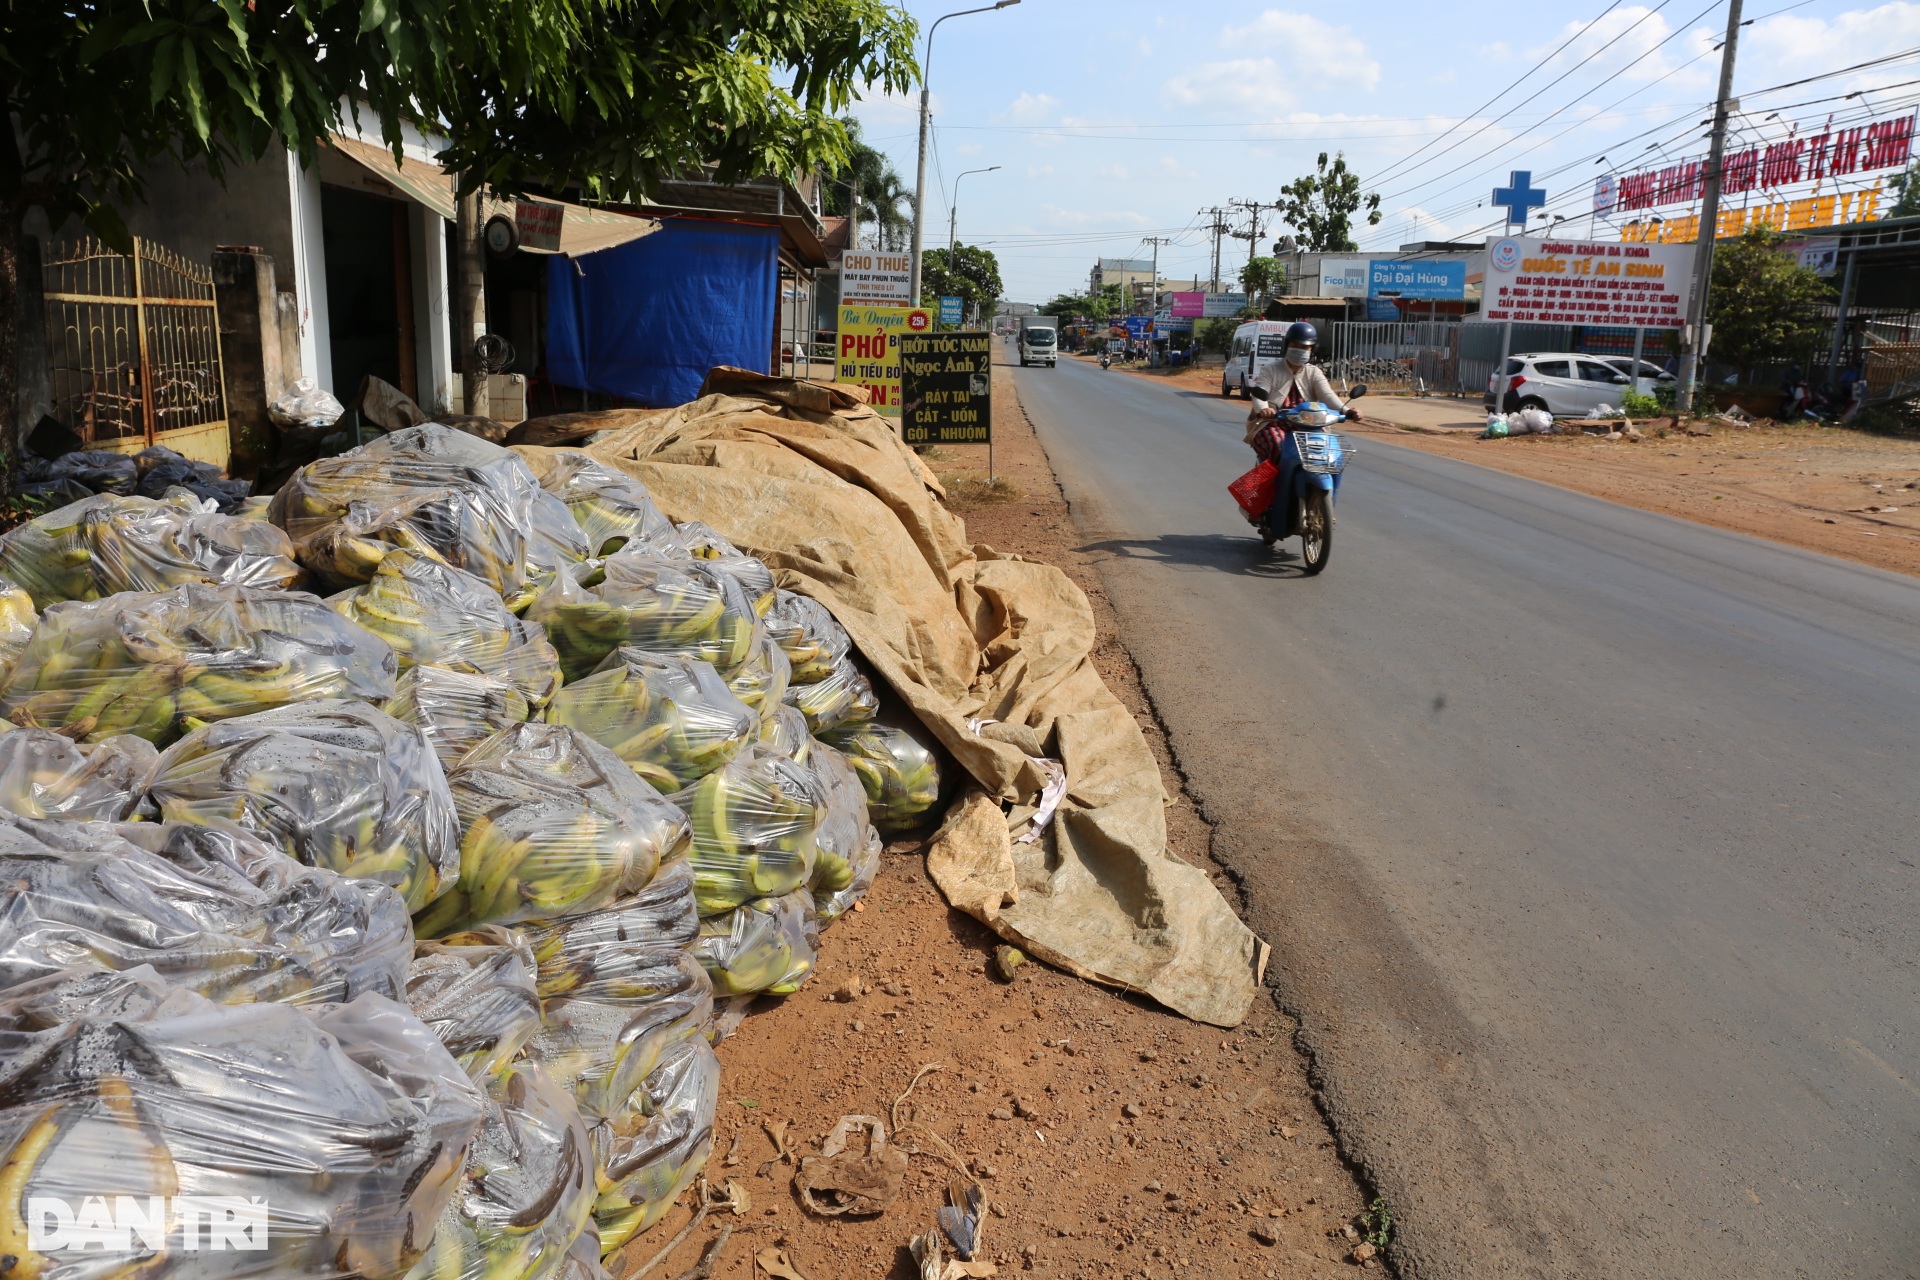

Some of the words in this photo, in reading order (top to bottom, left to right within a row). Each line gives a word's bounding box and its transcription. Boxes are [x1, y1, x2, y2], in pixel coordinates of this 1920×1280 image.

[1761, 122, 1806, 193] QUỐC
[1807, 113, 1834, 181] TẾ
[1829, 126, 1863, 177] AN
[1862, 114, 1915, 171] SINH
[1839, 192, 1854, 225] Y
[1854, 174, 1884, 224] TẾ
[1541, 242, 1574, 254] PHÒNG
[1576, 243, 1606, 256] KHÁM
[1624, 247, 1650, 258] KHOA
[845, 255, 872, 270] CHO
[876, 254, 910, 272] THUÊ
[1521, 254, 1567, 273] QUỐC
[1572, 255, 1594, 275] TẾ
[1595, 261, 1621, 276] AN
[1625, 263, 1665, 278] SINH
[890, 273, 909, 283] THUỐC
[1373, 272, 1392, 285] Đại
[1395, 272, 1414, 286] Đại
[1417, 272, 1448, 287] Hùng
[842, 309, 861, 324] Bà
[864, 309, 904, 328] Duyên
[912, 316, 925, 326] 25k
[1260, 324, 1287, 332] AMBUL
[841, 328, 887, 359] PHỞ
[902, 335, 930, 353] HỚT
[932, 335, 958, 352] TÓC
[960, 338, 990, 352] NAM
[842, 361, 856, 377] HỦ
[860, 361, 882, 378] TIẾU
[903, 357, 941, 376] Ngọc
[944, 356, 974, 372] Anh
[979, 355, 988, 373] 2
[925, 389, 949, 404] RÁY
[952, 391, 970, 403] TAI
[915, 406, 939, 422] CẮT
[951, 405, 977, 422] UỐN
[907, 425, 928, 443] GỘI
[940, 425, 986, 442] NHUỘM
